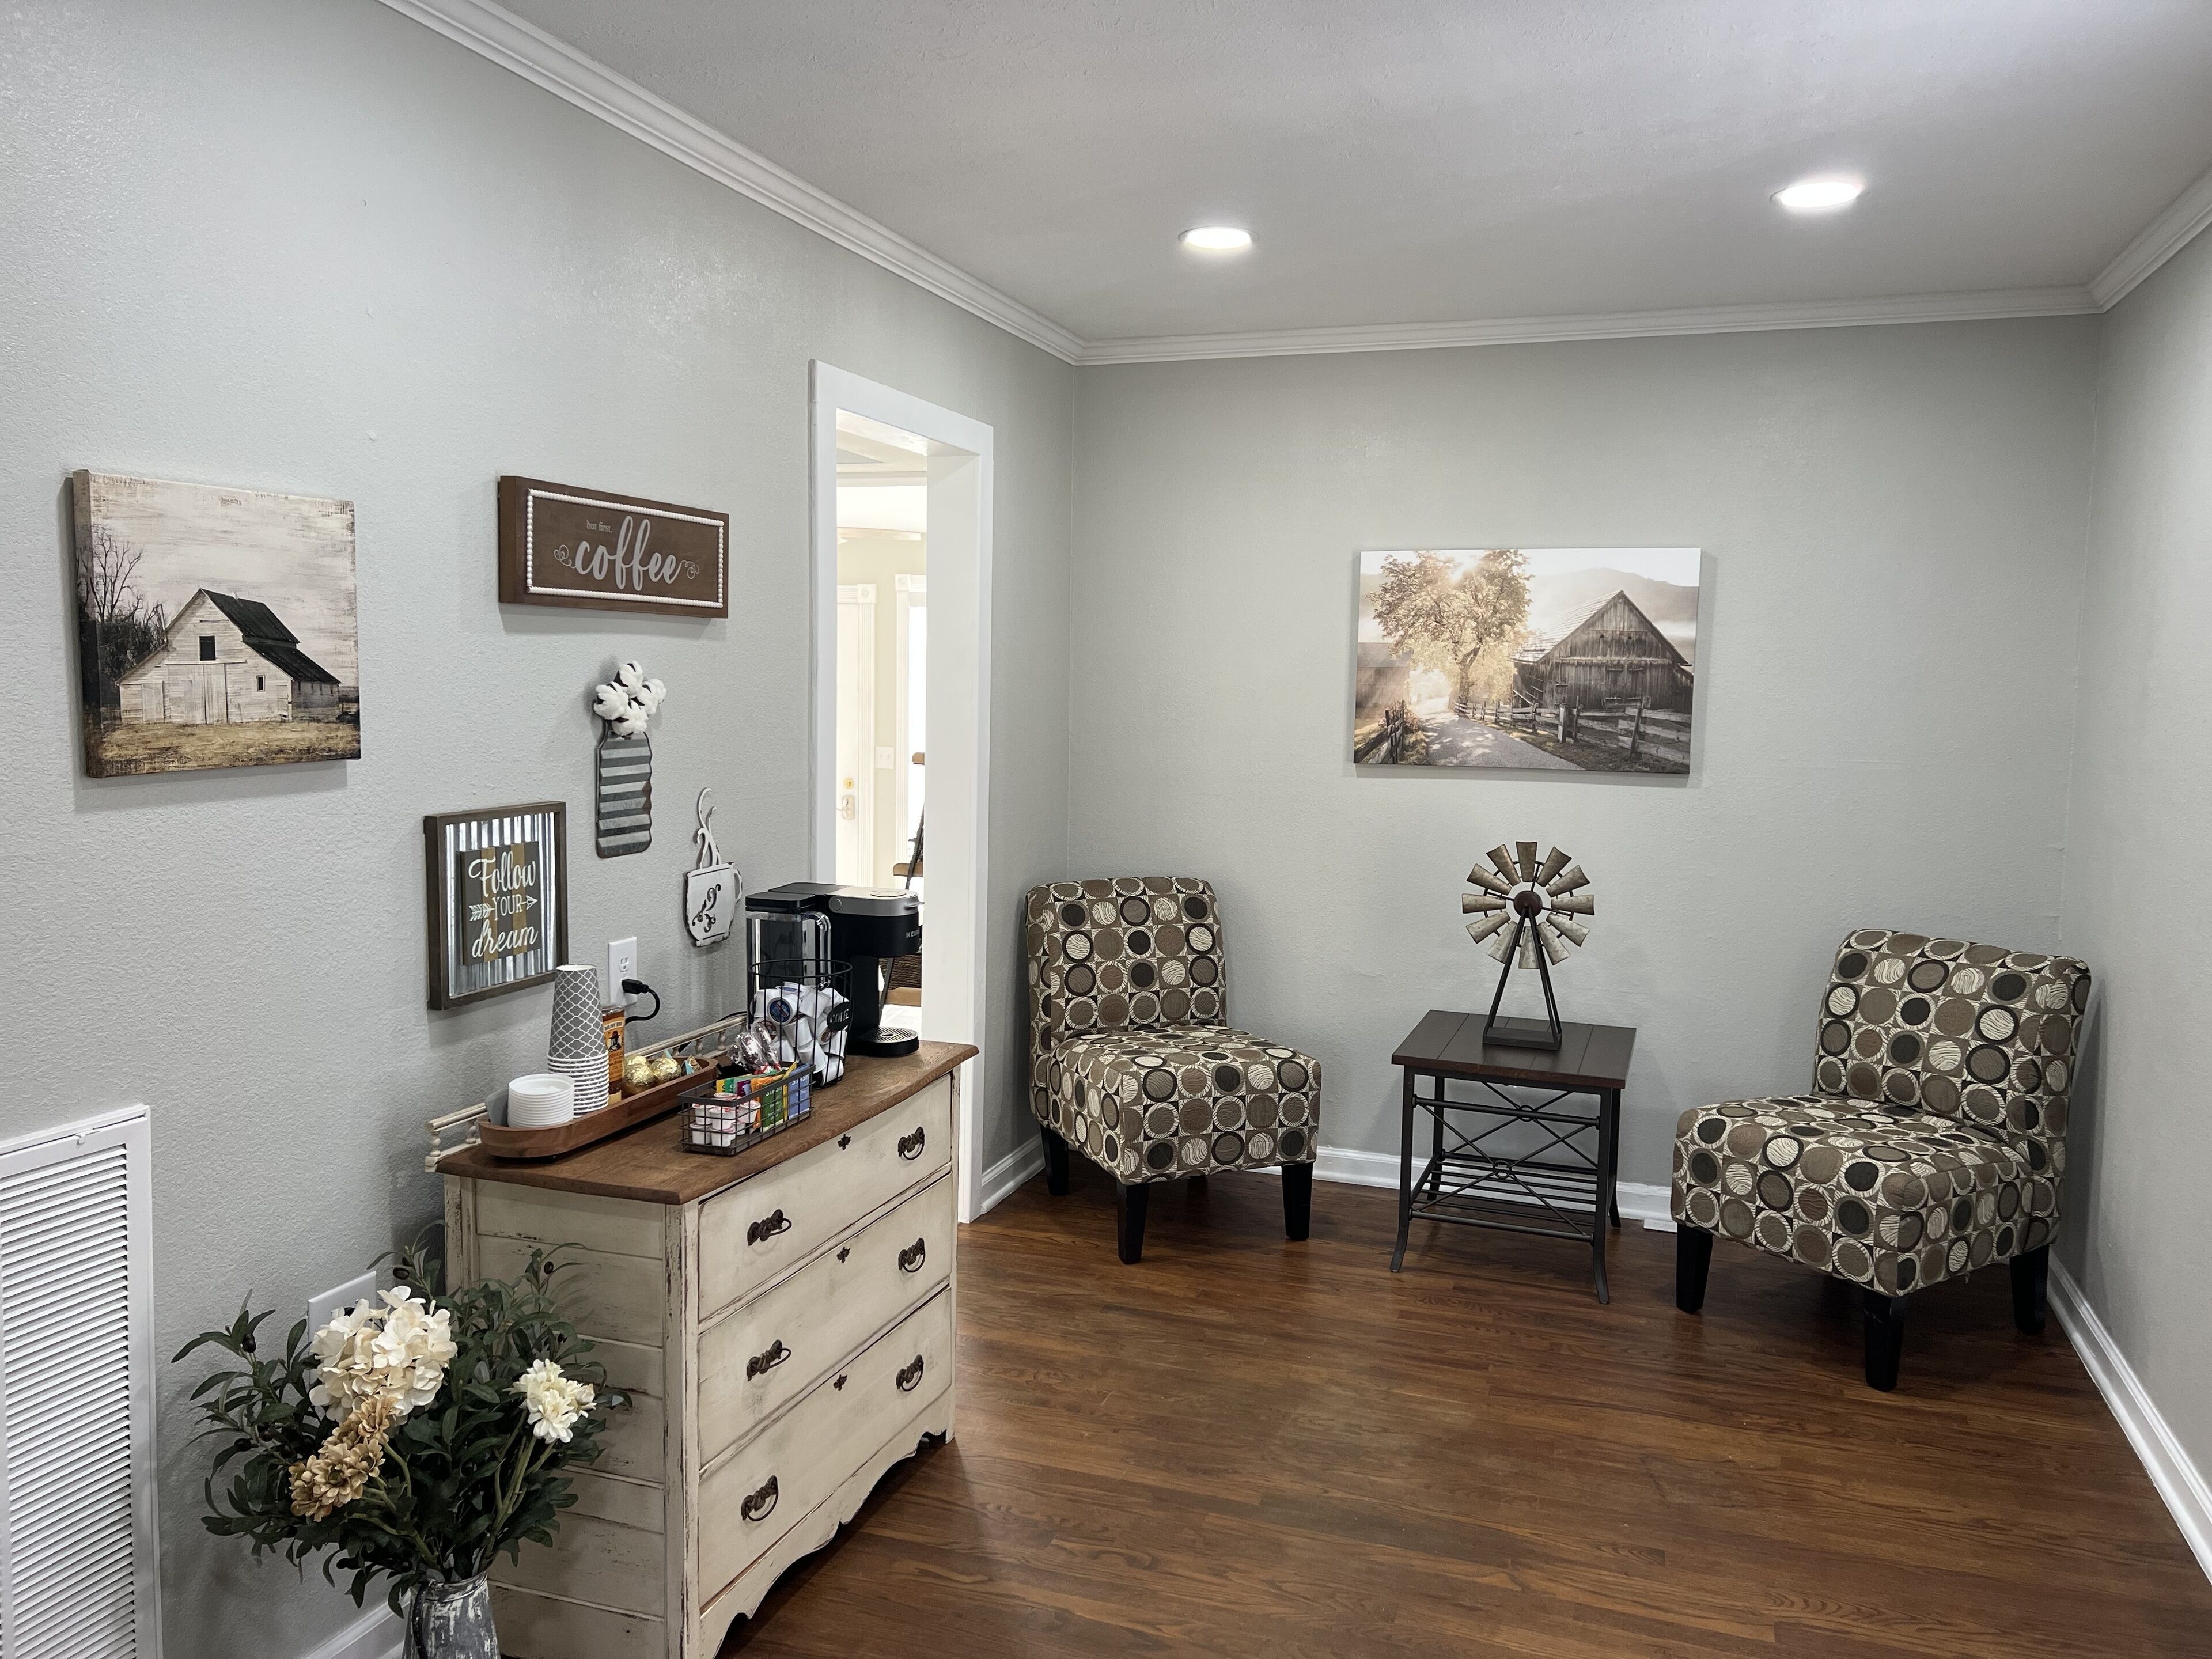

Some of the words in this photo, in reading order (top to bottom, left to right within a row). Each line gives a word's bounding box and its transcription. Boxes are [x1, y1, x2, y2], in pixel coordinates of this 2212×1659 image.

[586, 520, 597, 530] but
[575, 516, 683, 591] coffee
[468, 851, 536, 897] Follow
[493, 894, 522, 921] YOUR
[472, 919, 539, 958] dream
